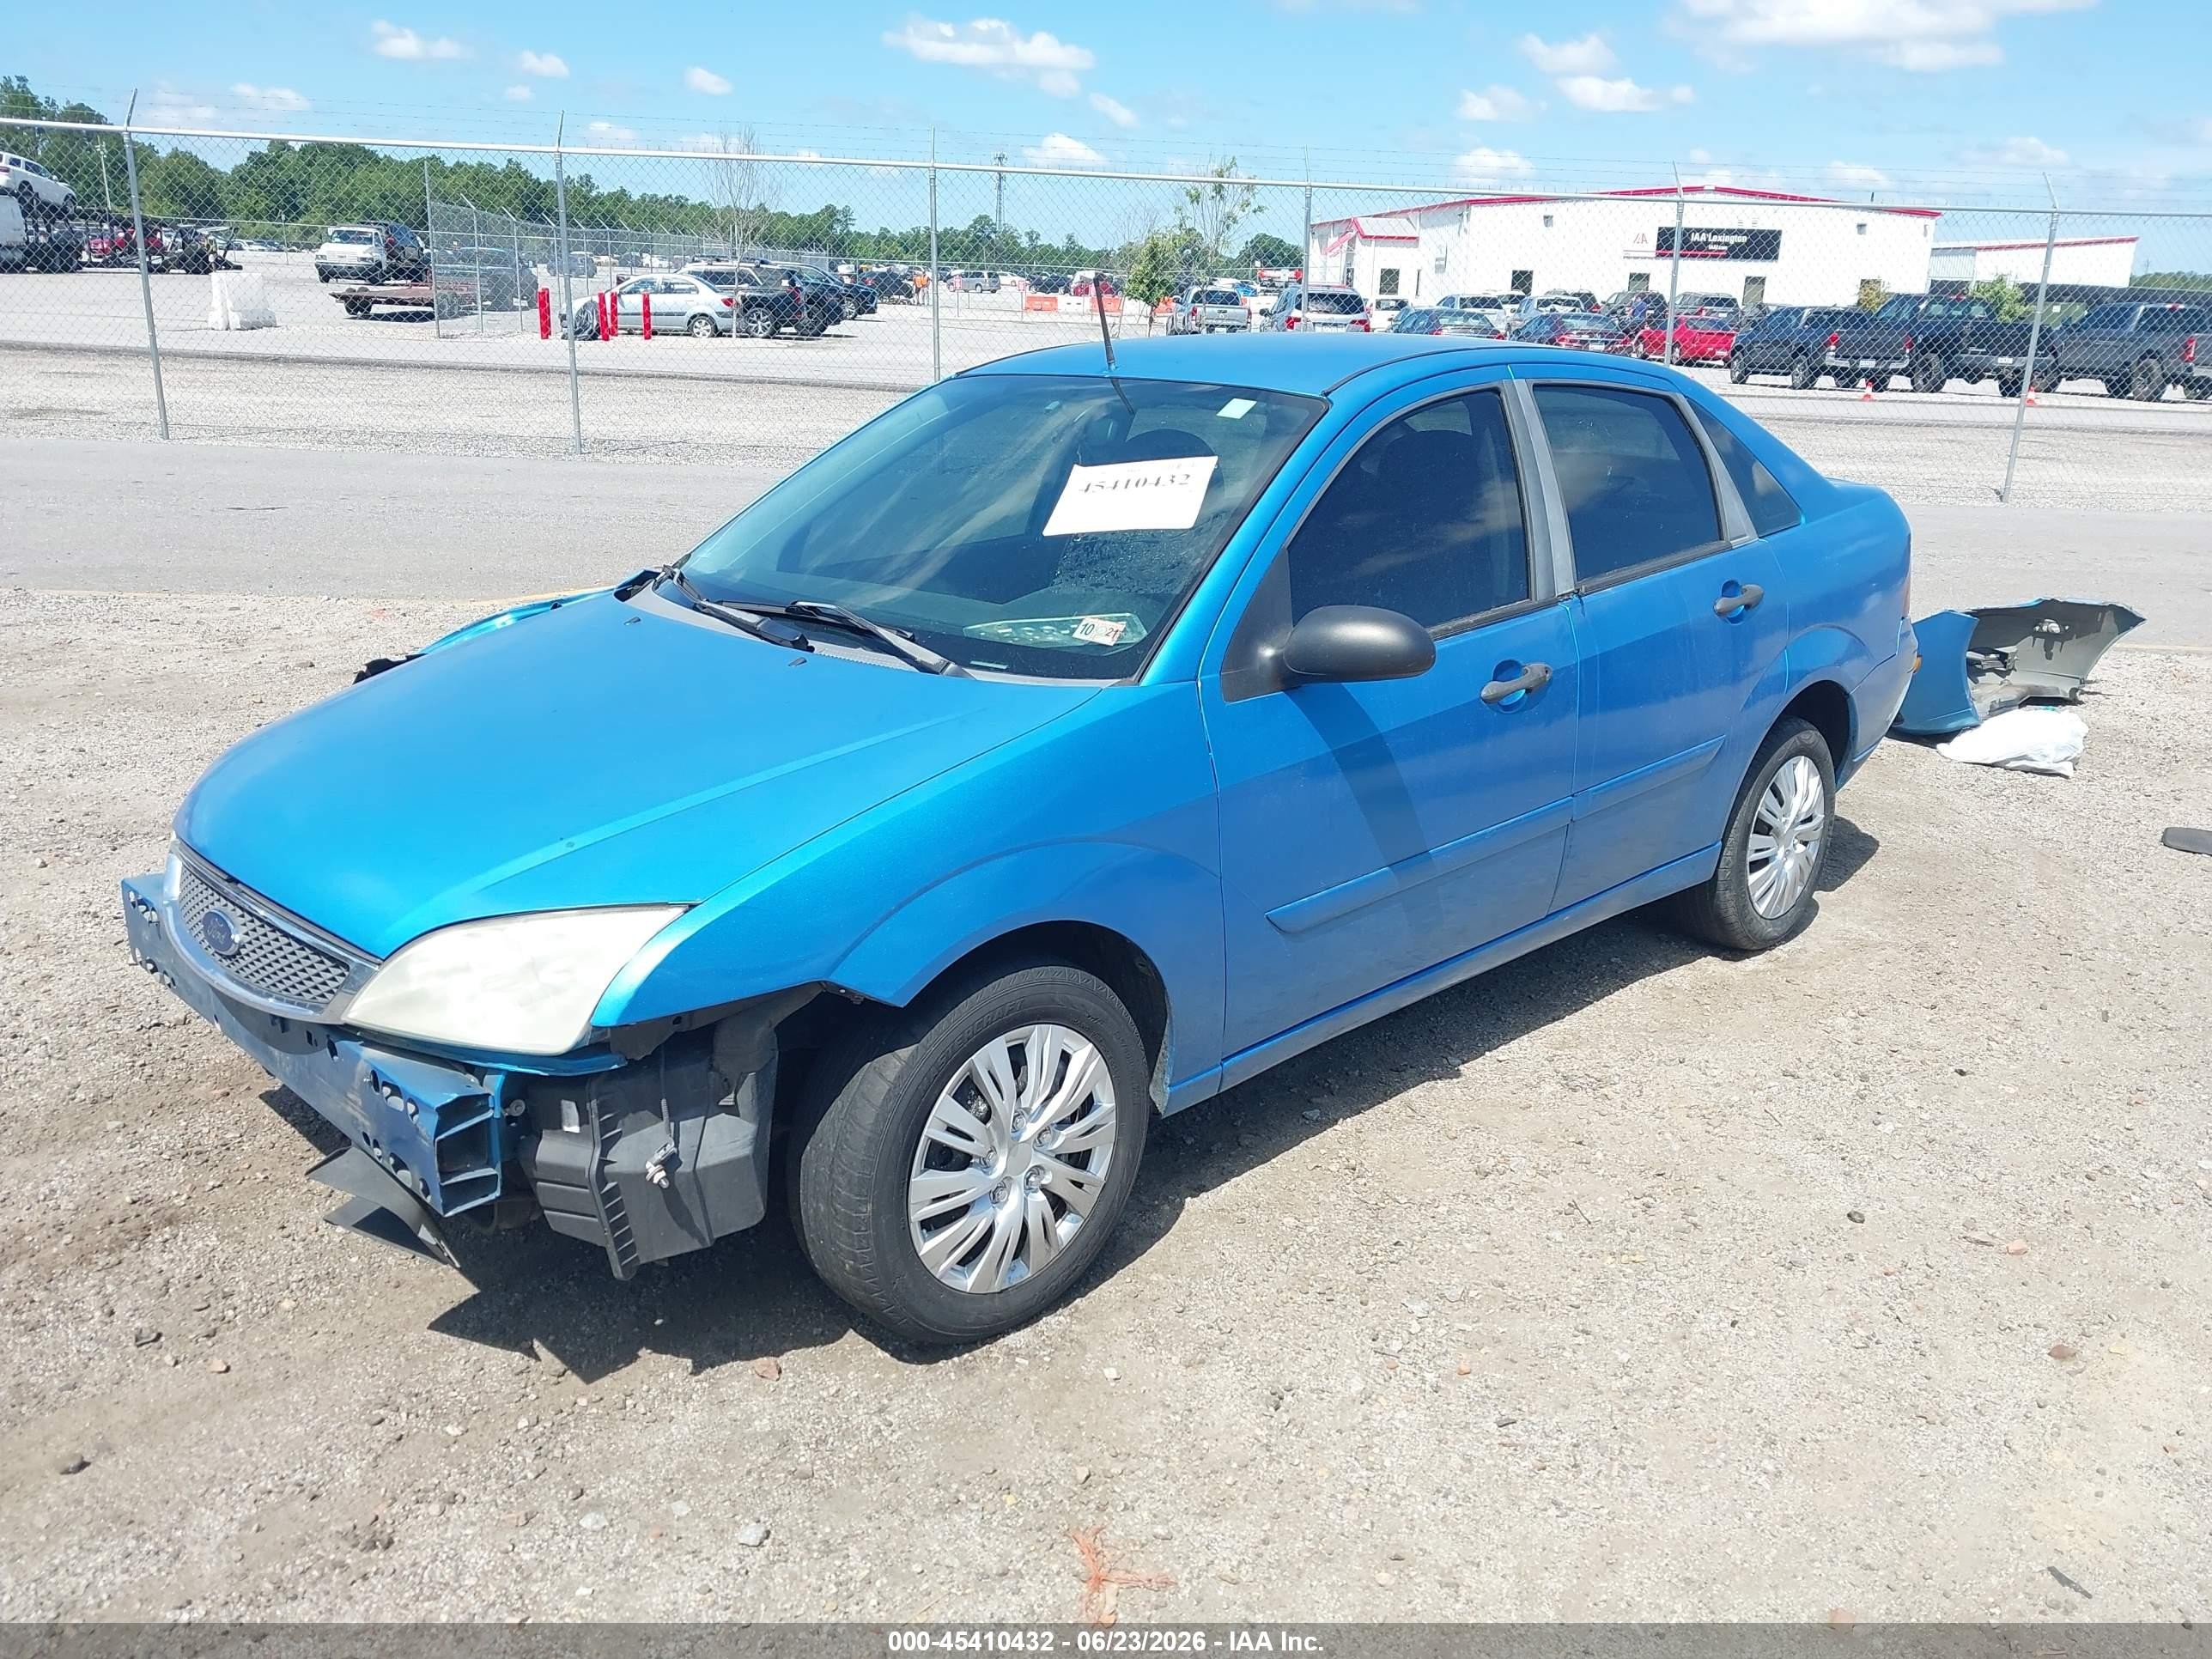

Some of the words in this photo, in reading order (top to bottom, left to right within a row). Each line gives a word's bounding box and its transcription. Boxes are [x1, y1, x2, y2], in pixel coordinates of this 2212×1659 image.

[1708, 232, 1747, 245] Lexington
[1079, 473, 1191, 493] 45410432
[1079, 622, 1095, 635] 10
[1105, 627, 1120, 639] 21
